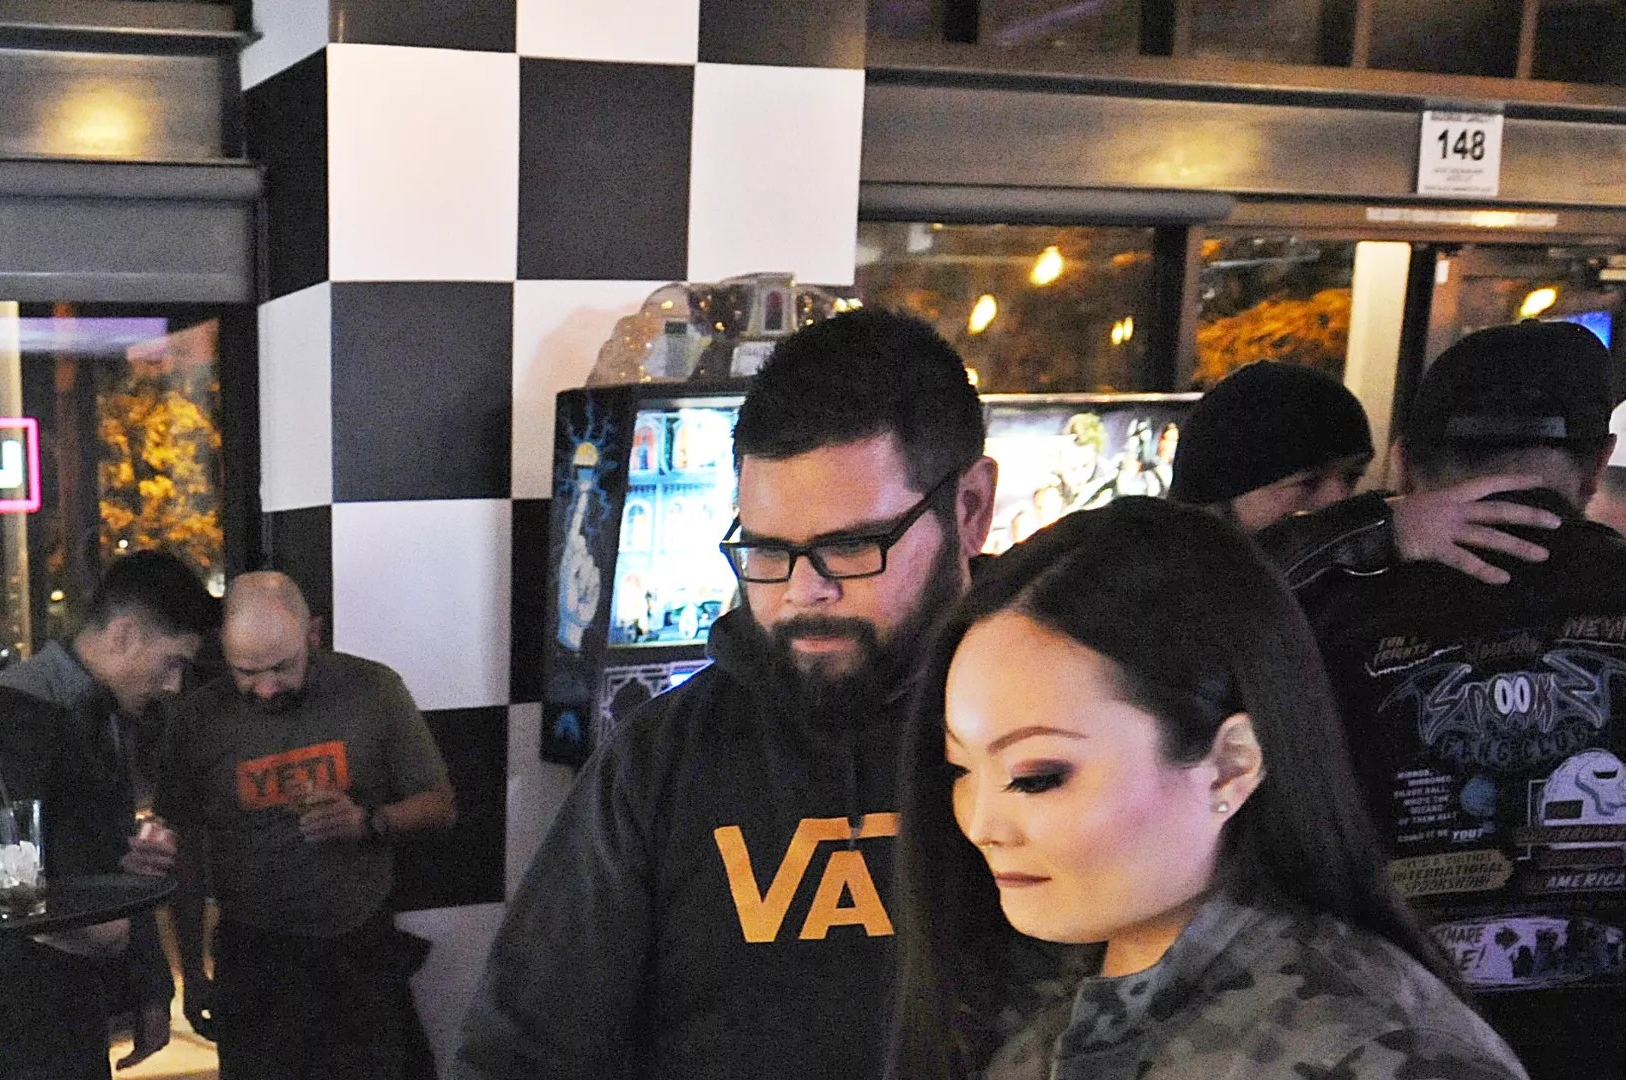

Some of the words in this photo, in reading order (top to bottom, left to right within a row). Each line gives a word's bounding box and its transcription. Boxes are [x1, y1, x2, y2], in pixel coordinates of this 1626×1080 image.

[1438, 128, 1486, 161] 148
[246, 755, 338, 798] YETI
[714, 811, 900, 943] VA
